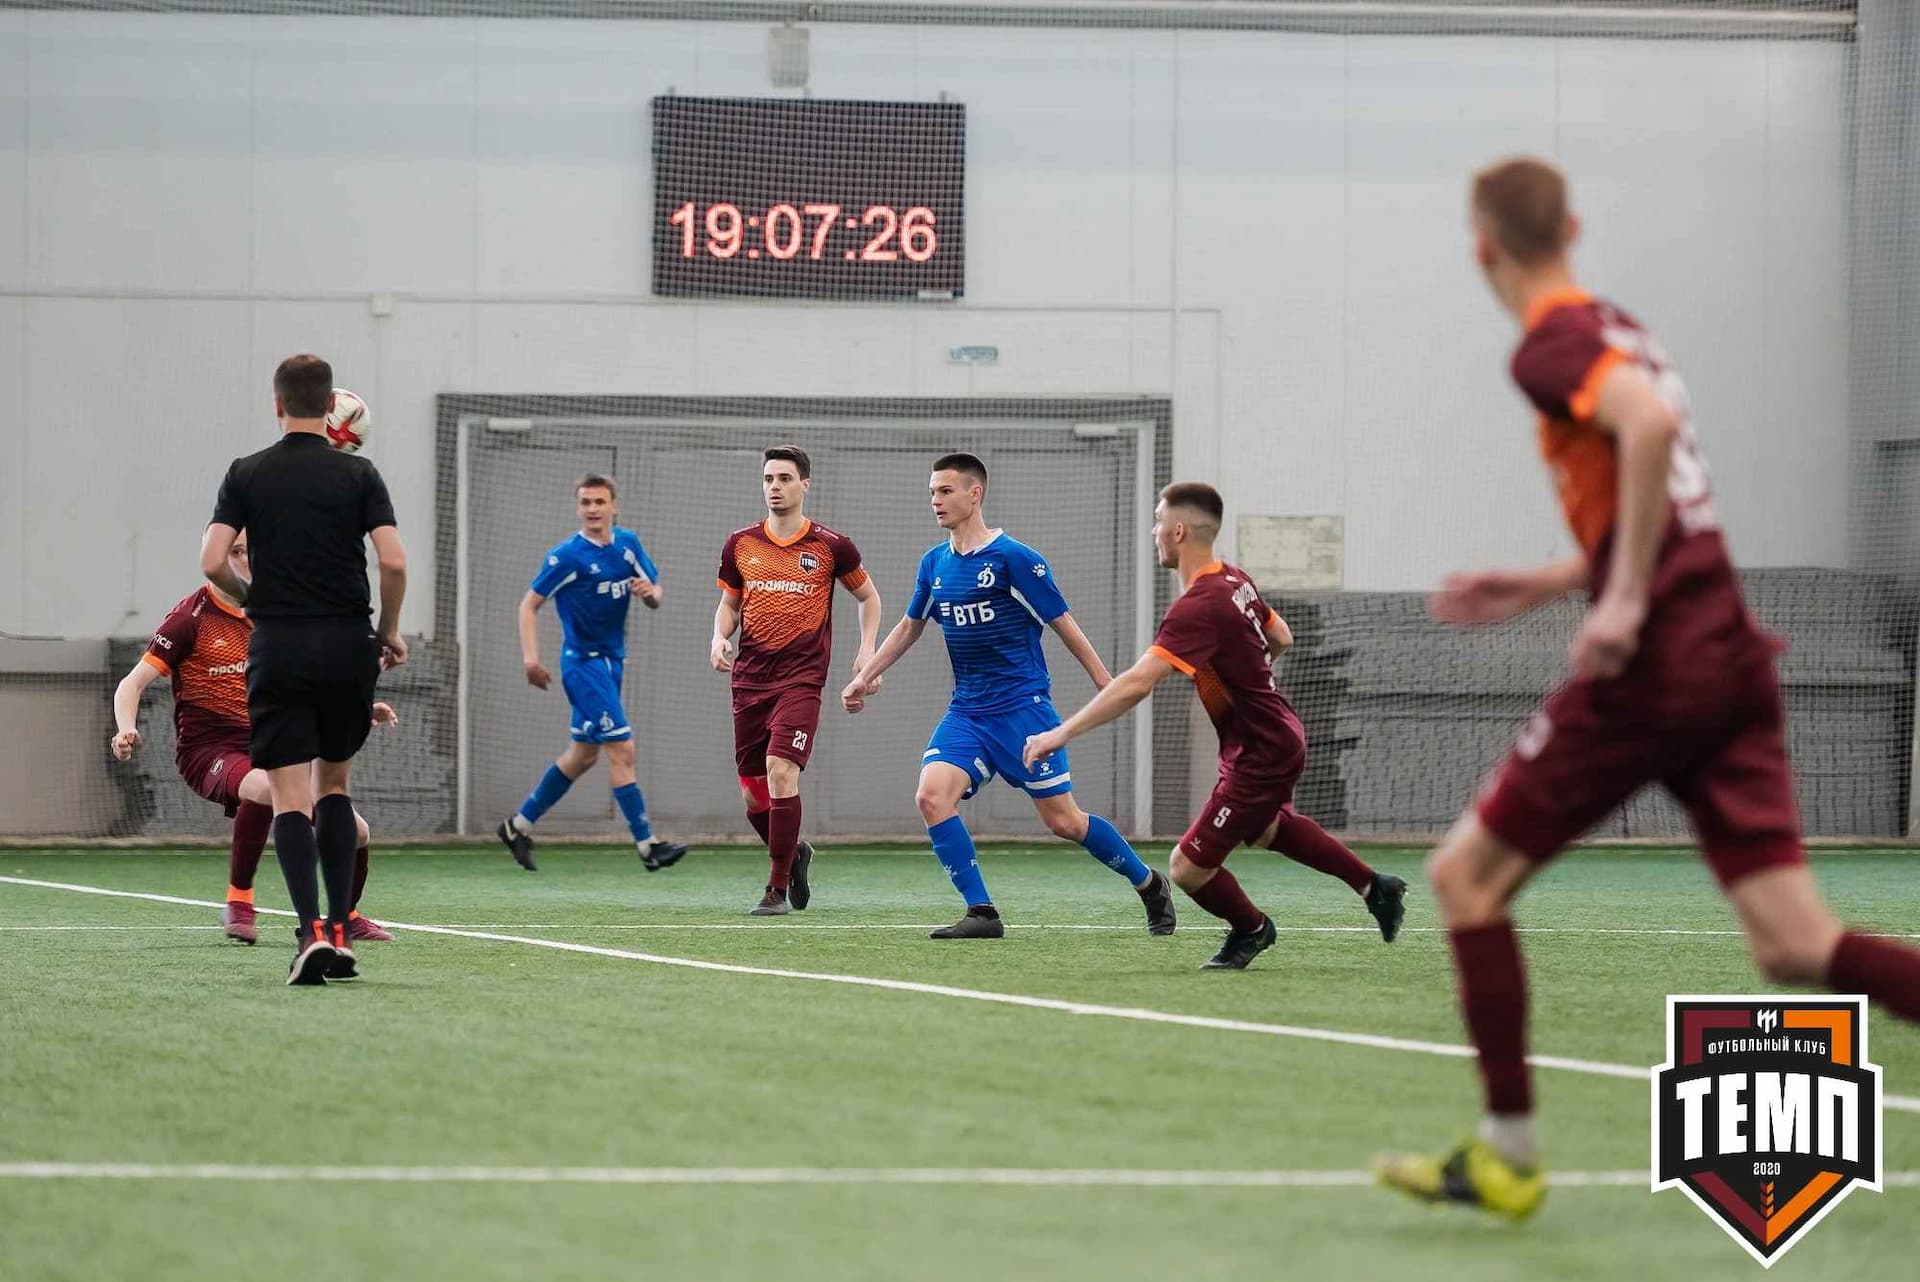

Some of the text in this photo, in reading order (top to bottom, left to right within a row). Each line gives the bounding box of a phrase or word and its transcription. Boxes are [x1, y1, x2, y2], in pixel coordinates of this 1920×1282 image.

[670, 201, 938, 262] 19:07:26
[611, 577, 633, 600] ВТ
[953, 600, 995, 626] ВТБ
[792, 730, 808, 750] 23
